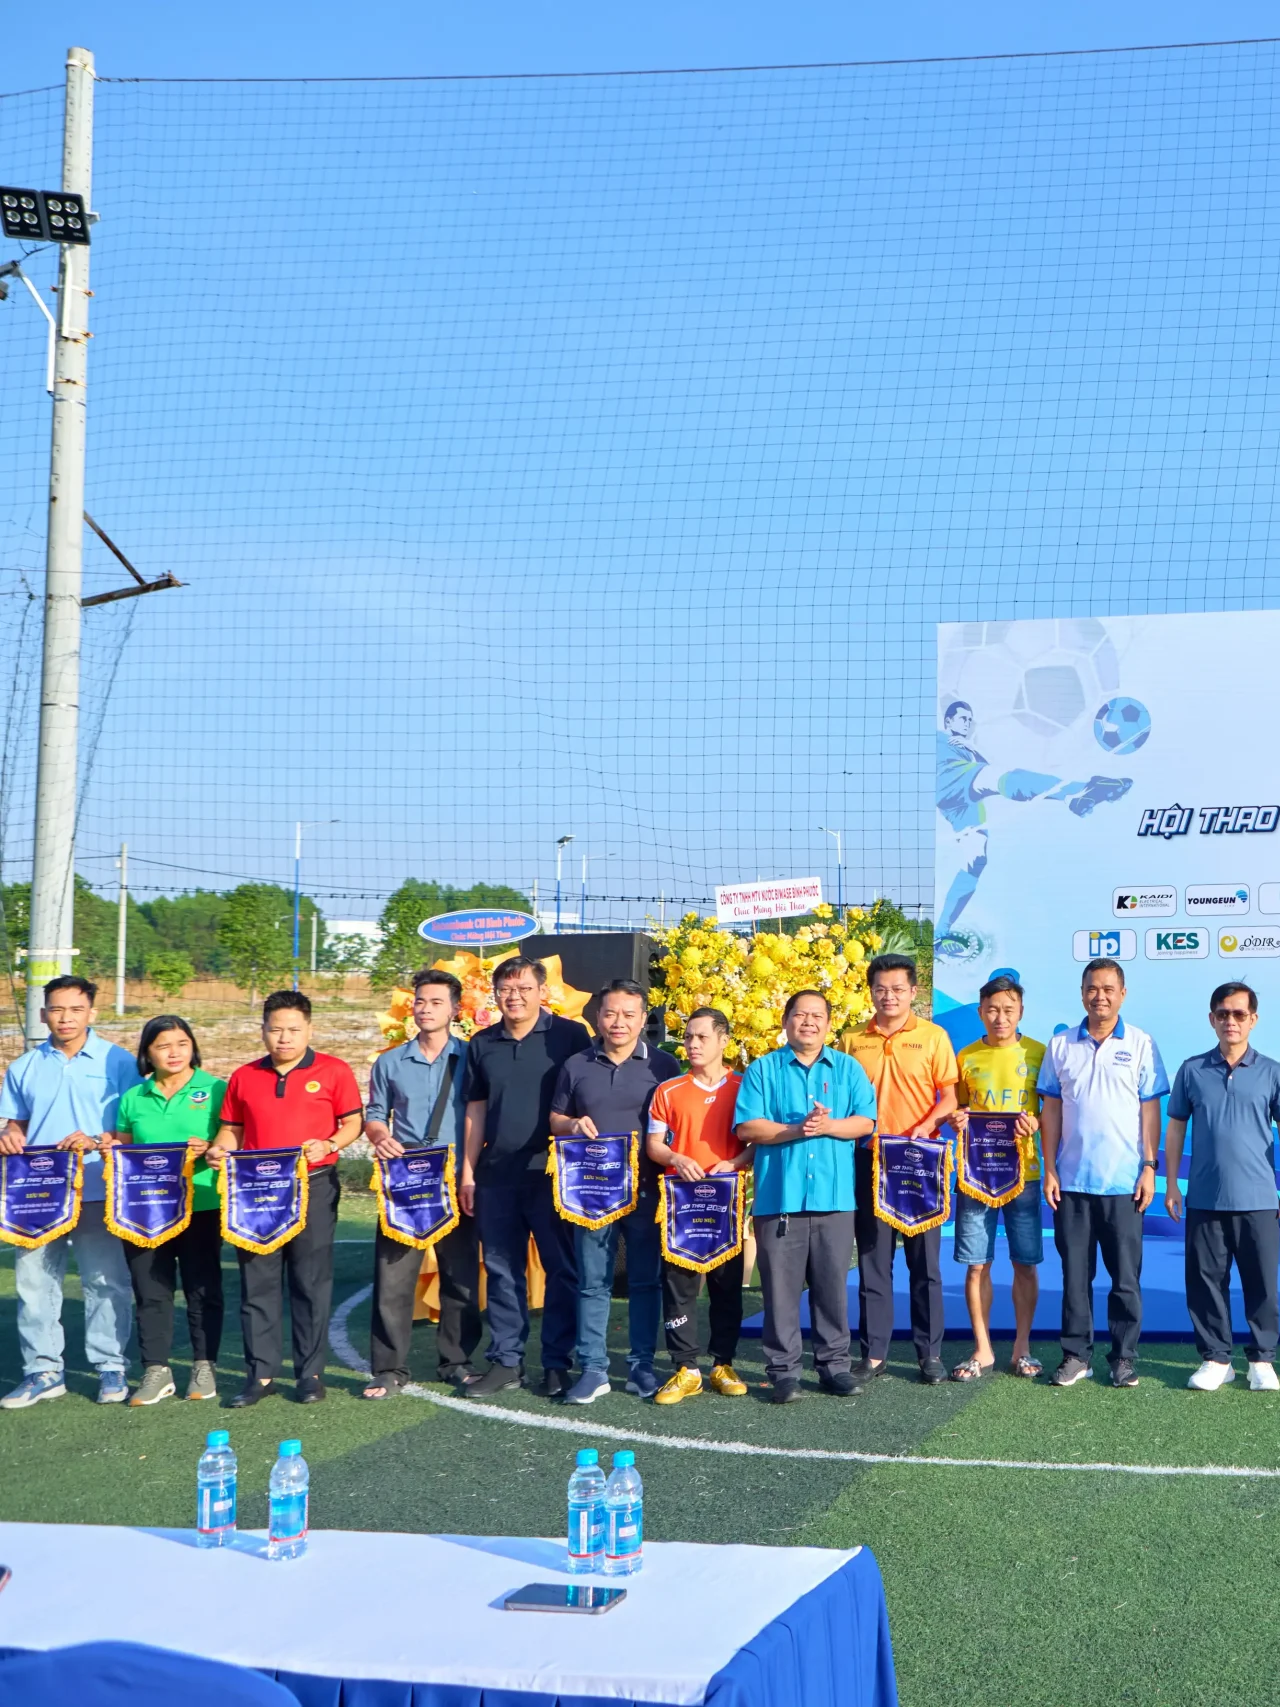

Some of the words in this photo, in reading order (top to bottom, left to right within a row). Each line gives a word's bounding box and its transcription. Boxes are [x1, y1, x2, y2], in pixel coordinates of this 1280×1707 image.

[1137, 803, 1193, 840] HỘI
[1199, 805, 1280, 835] THAO
[1188, 896, 1236, 905] YOUNGEUN
[1156, 933, 1199, 950] KES
